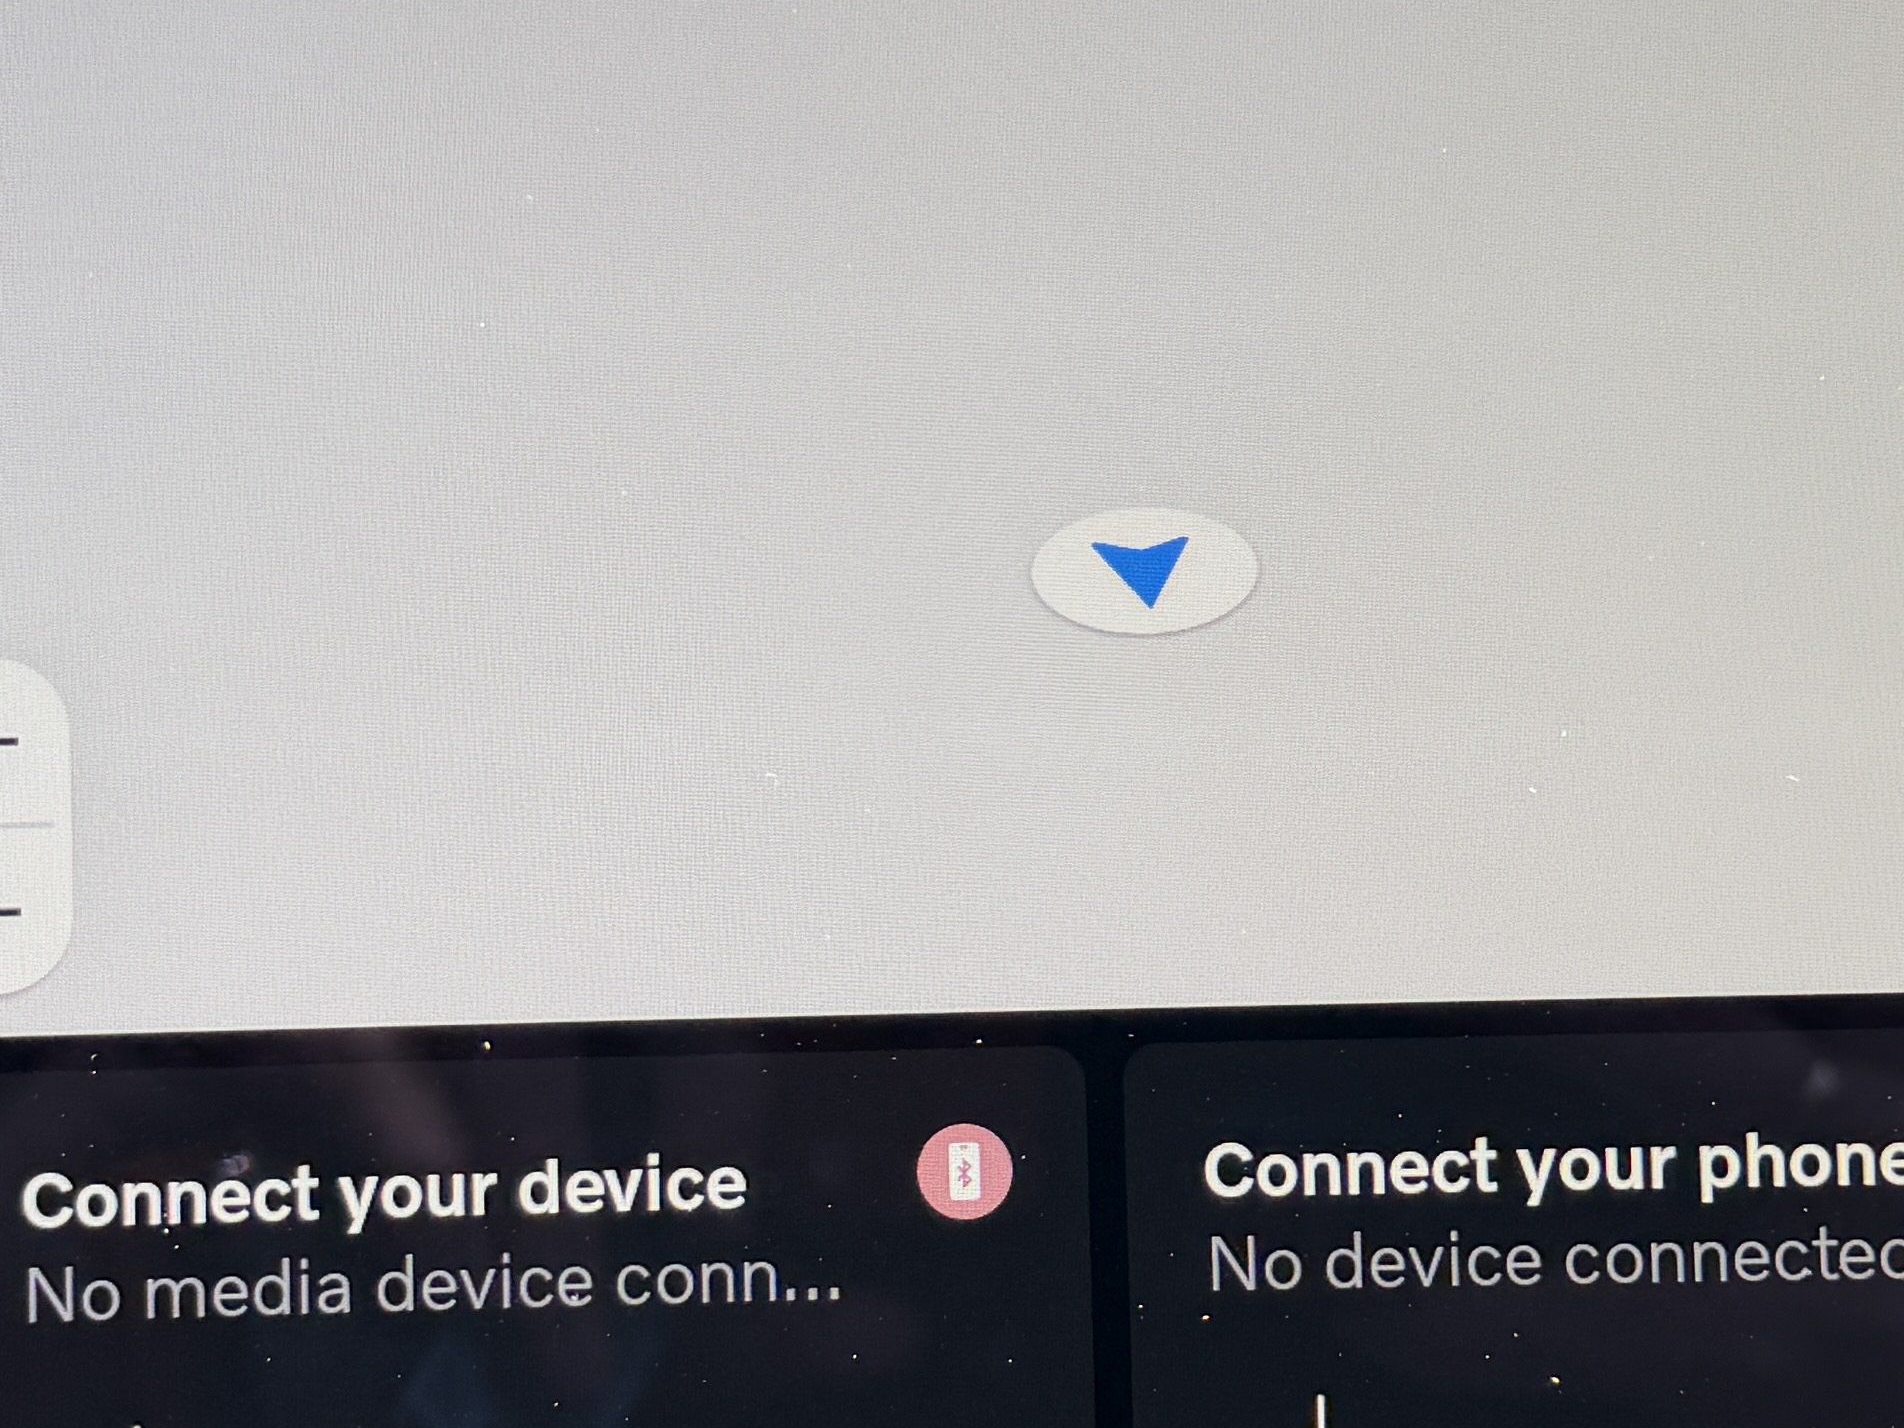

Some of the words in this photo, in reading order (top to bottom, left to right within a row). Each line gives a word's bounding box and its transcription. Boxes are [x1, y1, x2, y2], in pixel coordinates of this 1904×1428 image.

[23, 1165, 319, 1228] Connect
[338, 1173, 497, 1234] your
[519, 1153, 746, 1214] device
[1205, 1137, 1498, 1197] Connect
[1516, 1146, 1676, 1206] your
[29, 1267, 120, 1323] No
[147, 1258, 350, 1319] media
[378, 1253, 592, 1311] device
[617, 1262, 839, 1305] conn...
[1212, 1236, 1301, 1291] No
[1327, 1231, 1541, 1288] device
